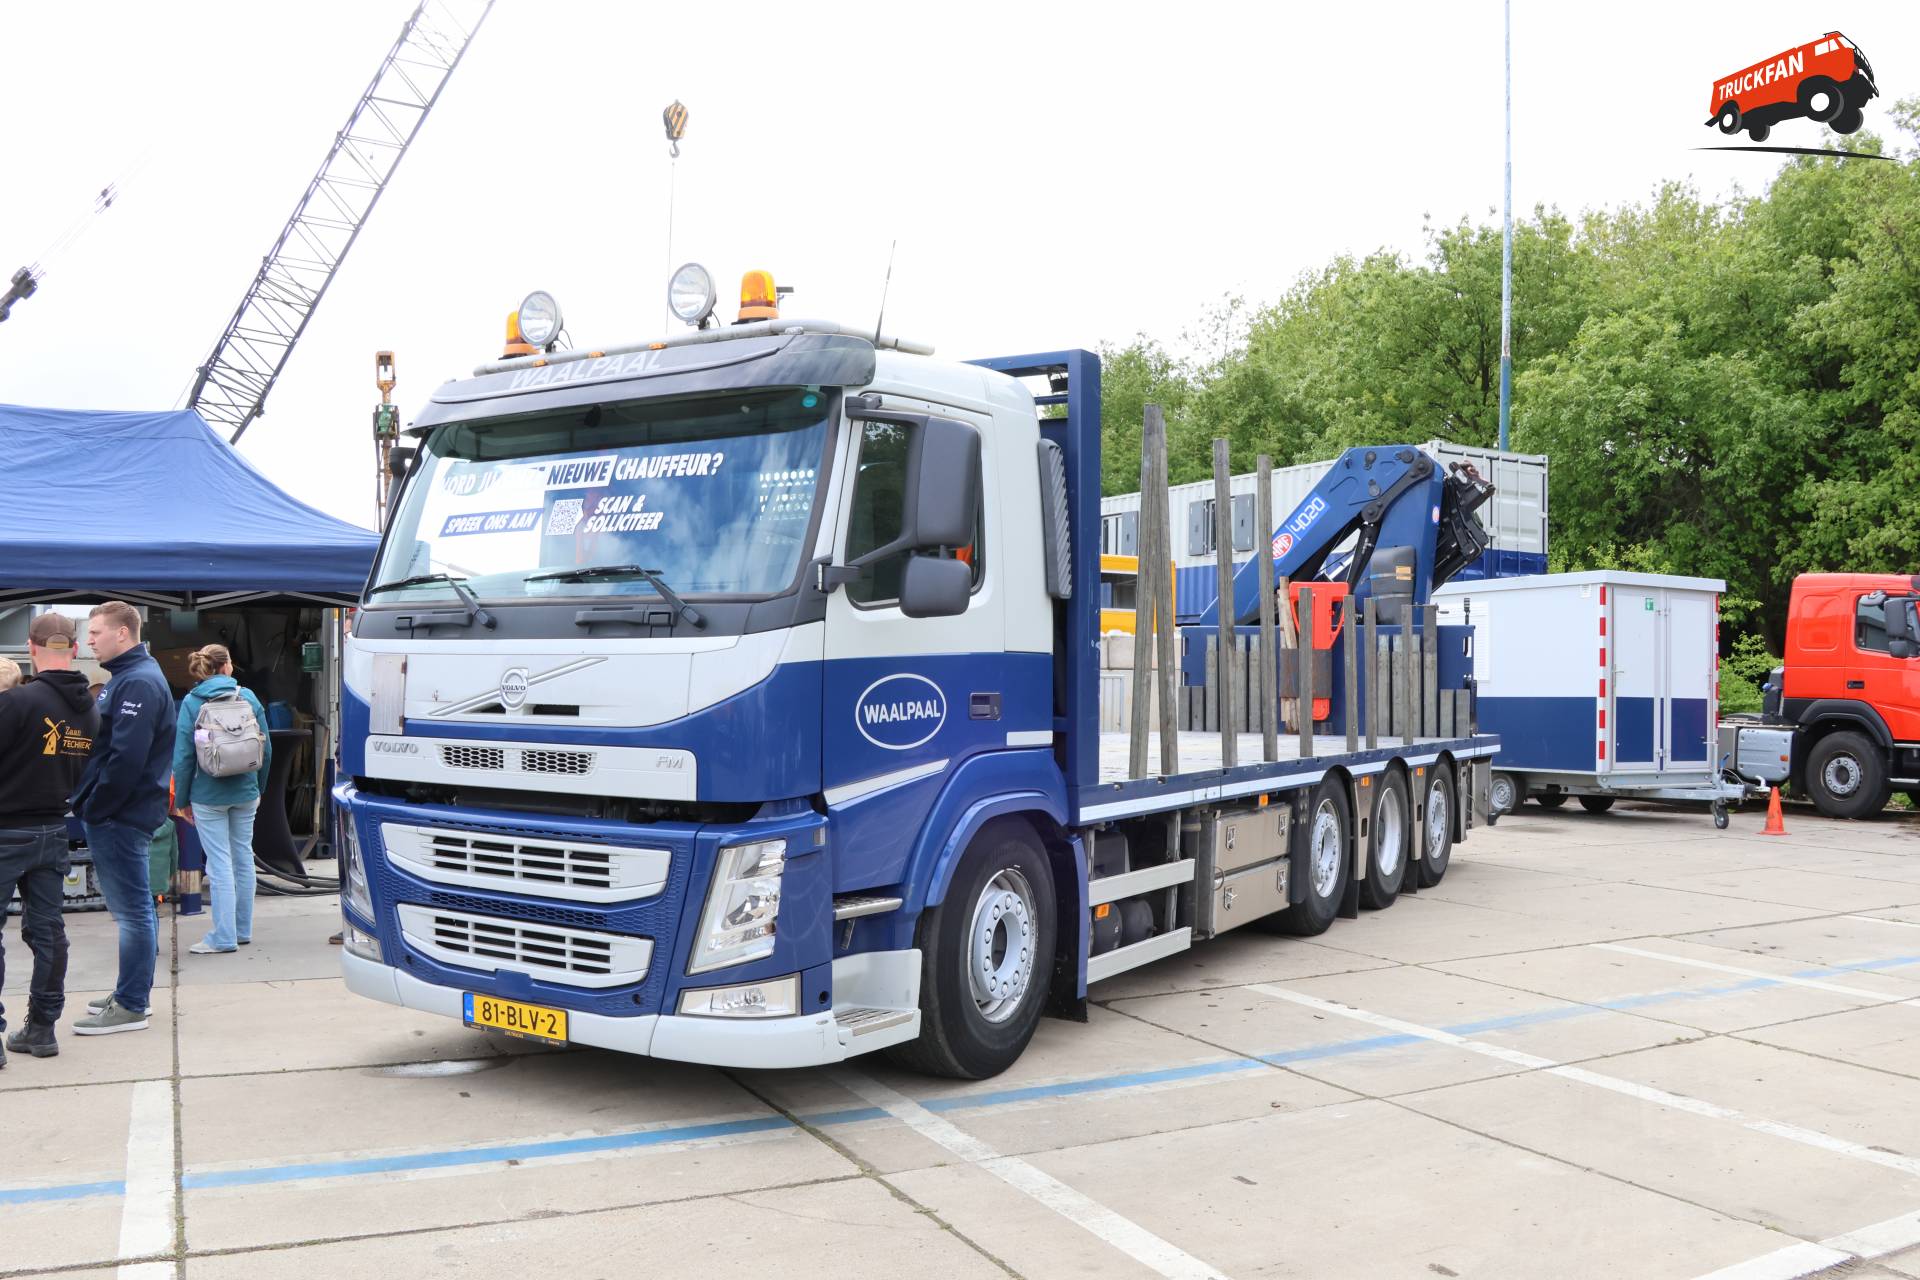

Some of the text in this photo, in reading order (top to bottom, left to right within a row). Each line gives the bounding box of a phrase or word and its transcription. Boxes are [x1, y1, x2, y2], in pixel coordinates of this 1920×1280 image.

[510, 350, 661, 391] WAALPAAL
[547, 461, 610, 486] NIEUWE
[615, 453, 723, 481] CHAUFFEUR?
[594, 495, 646, 515] SCAN &
[1290, 497, 1325, 532] 4020
[445, 512, 538, 533] SPREEK ONS AAN
[583, 512, 664, 533] SOLLICITEER
[502, 684, 526, 692] VOLVO
[864, 699, 941, 724] WAALPAAL
[373, 741, 419, 753] VOLVO
[656, 755, 684, 769] FM
[482, 1001, 557, 1035] 81-BLV-2
